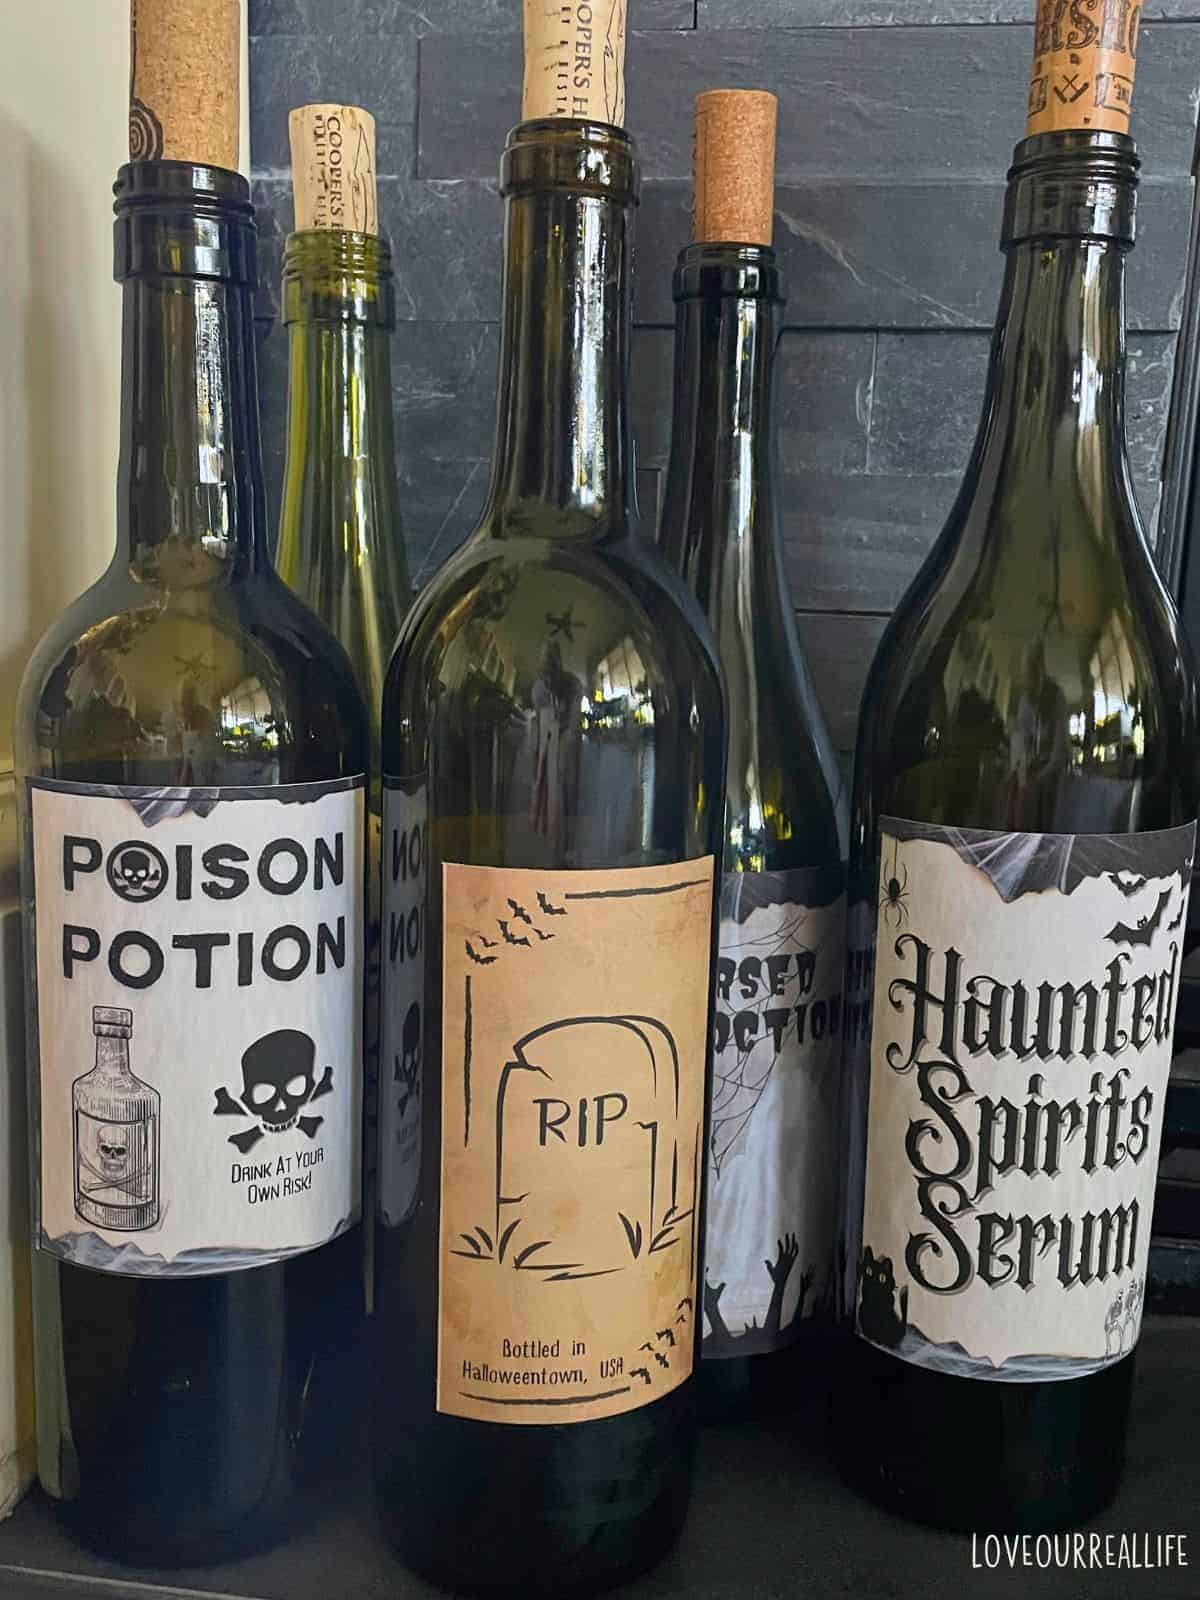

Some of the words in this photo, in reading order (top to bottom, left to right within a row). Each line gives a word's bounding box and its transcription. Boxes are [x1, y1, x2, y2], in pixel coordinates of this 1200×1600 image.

[572, 0, 594, 89] OPER'S
[327, 116, 344, 216] COOPER'S
[63, 832, 344, 903] POISON
[63, 915, 345, 989] POTION
[885, 933, 1178, 1072] Haunted
[532, 1092, 628, 1147] RIP
[904, 1059, 1153, 1202] Spirits
[231, 1163, 273, 1184] DRINK
[276, 1155, 292, 1176] AT
[295, 1147, 324, 1169] YOUR
[248, 1184, 280, 1204] OWN
[283, 1170, 312, 1197] RISK!
[904, 1175, 1140, 1296] Serum
[462, 1360, 588, 1385] Halloweentown,
[600, 1356, 624, 1379] USA
[502, 1338, 560, 1359] Bottled
[571, 1339, 586, 1356] in
